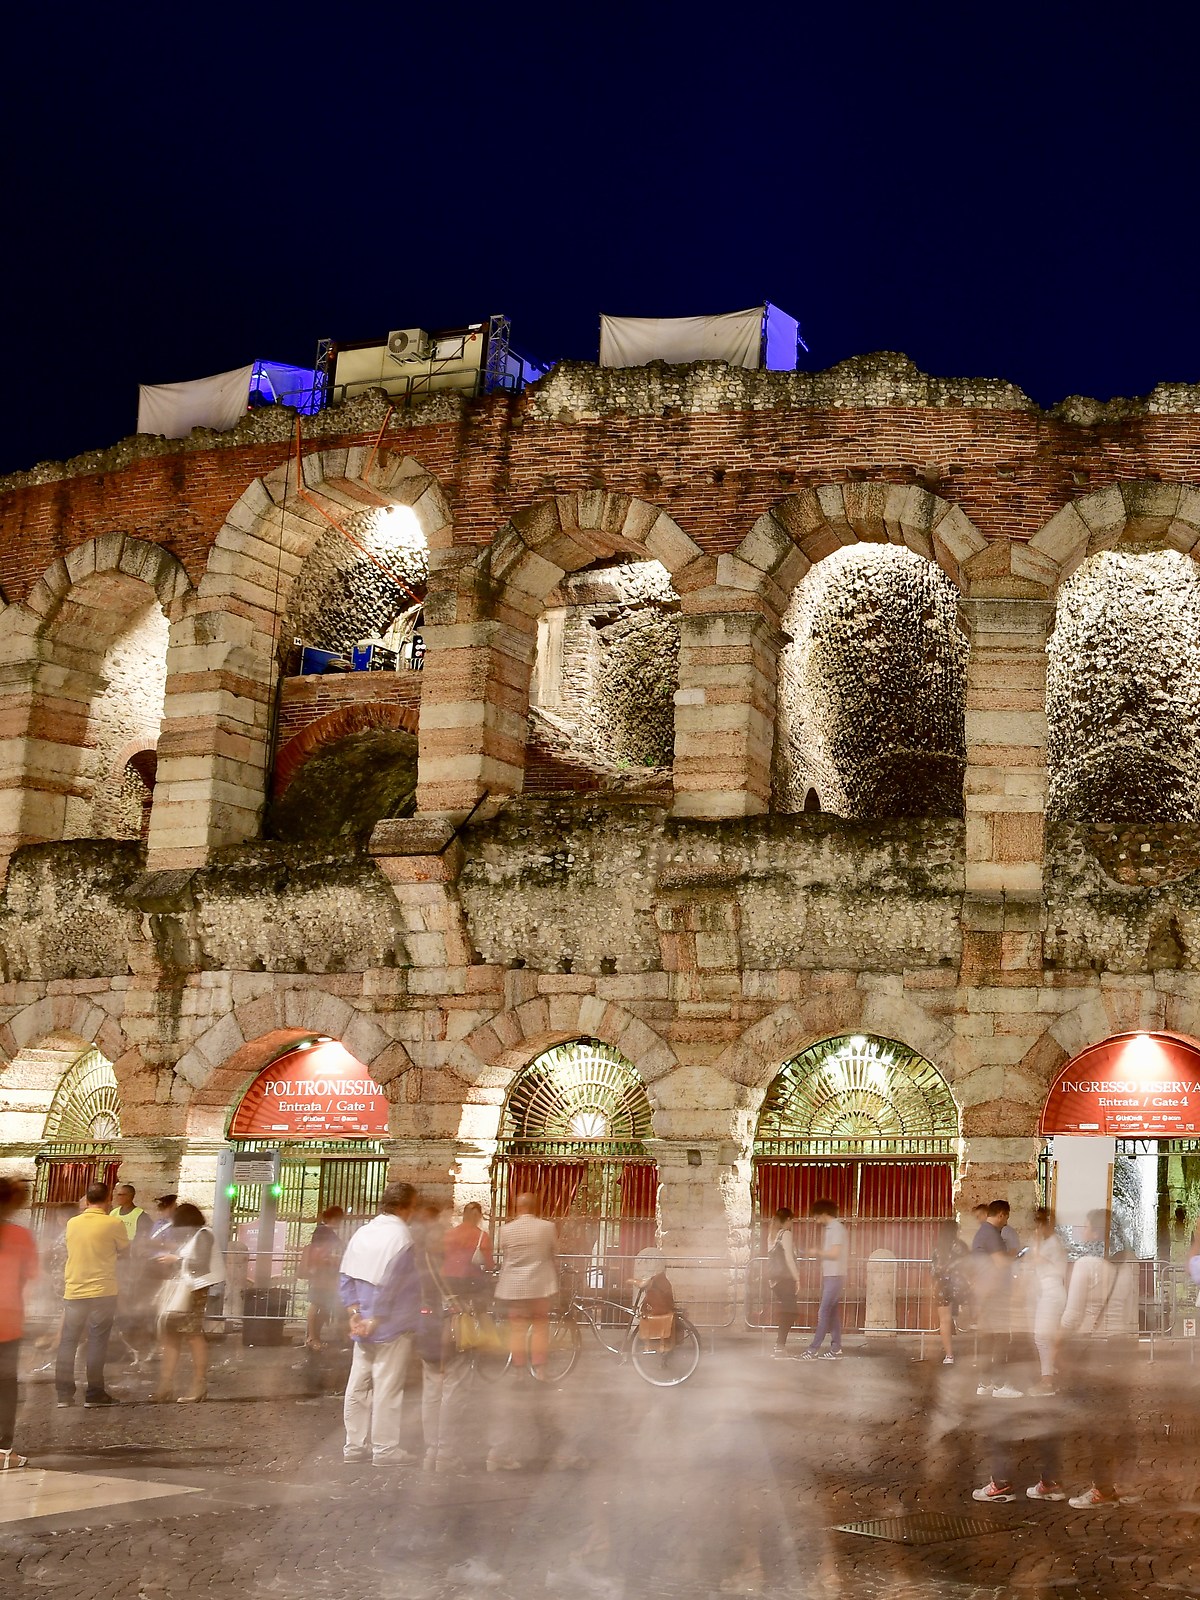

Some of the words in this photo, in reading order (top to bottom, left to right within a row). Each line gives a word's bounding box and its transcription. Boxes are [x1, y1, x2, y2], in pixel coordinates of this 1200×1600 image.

[1061, 1081, 1137, 1093] INGRESSO
[278, 1101, 322, 1112] Entrata
[325, 1100, 333, 1113] /
[336, 1101, 366, 1112] Gate
[369, 1101, 375, 1112] 1
[1098, 1097, 1139, 1107] Entrata
[1143, 1097, 1149, 1107] /
[1152, 1097, 1179, 1107] Gate
[1180, 1096, 1189, 1107] 4
